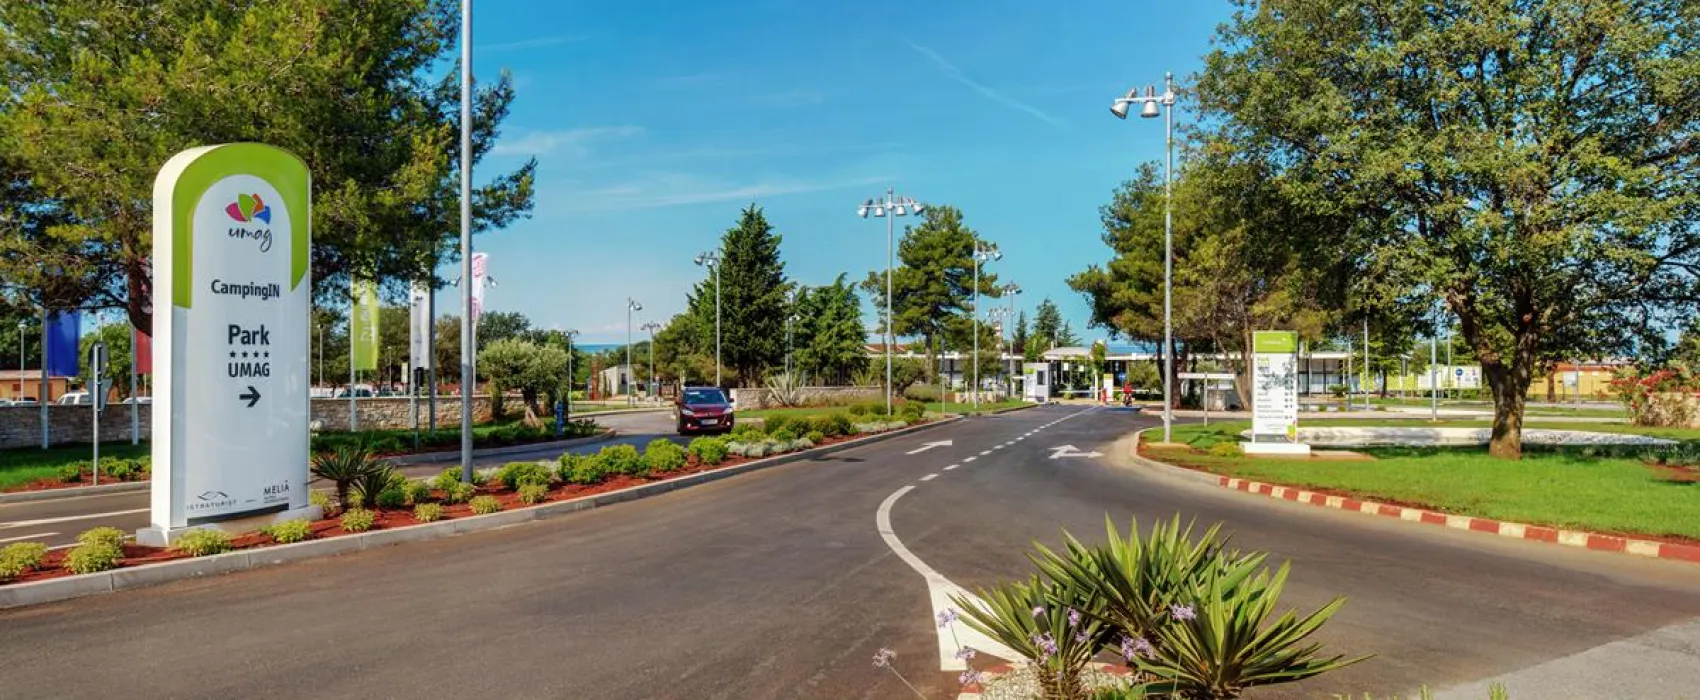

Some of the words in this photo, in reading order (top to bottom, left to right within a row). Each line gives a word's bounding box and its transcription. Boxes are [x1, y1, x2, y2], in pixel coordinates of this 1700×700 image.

[228, 227, 272, 253] umag
[211, 279, 280, 301] CampingIN
[228, 323, 270, 346] Park
[228, 362, 270, 378] UMAG
